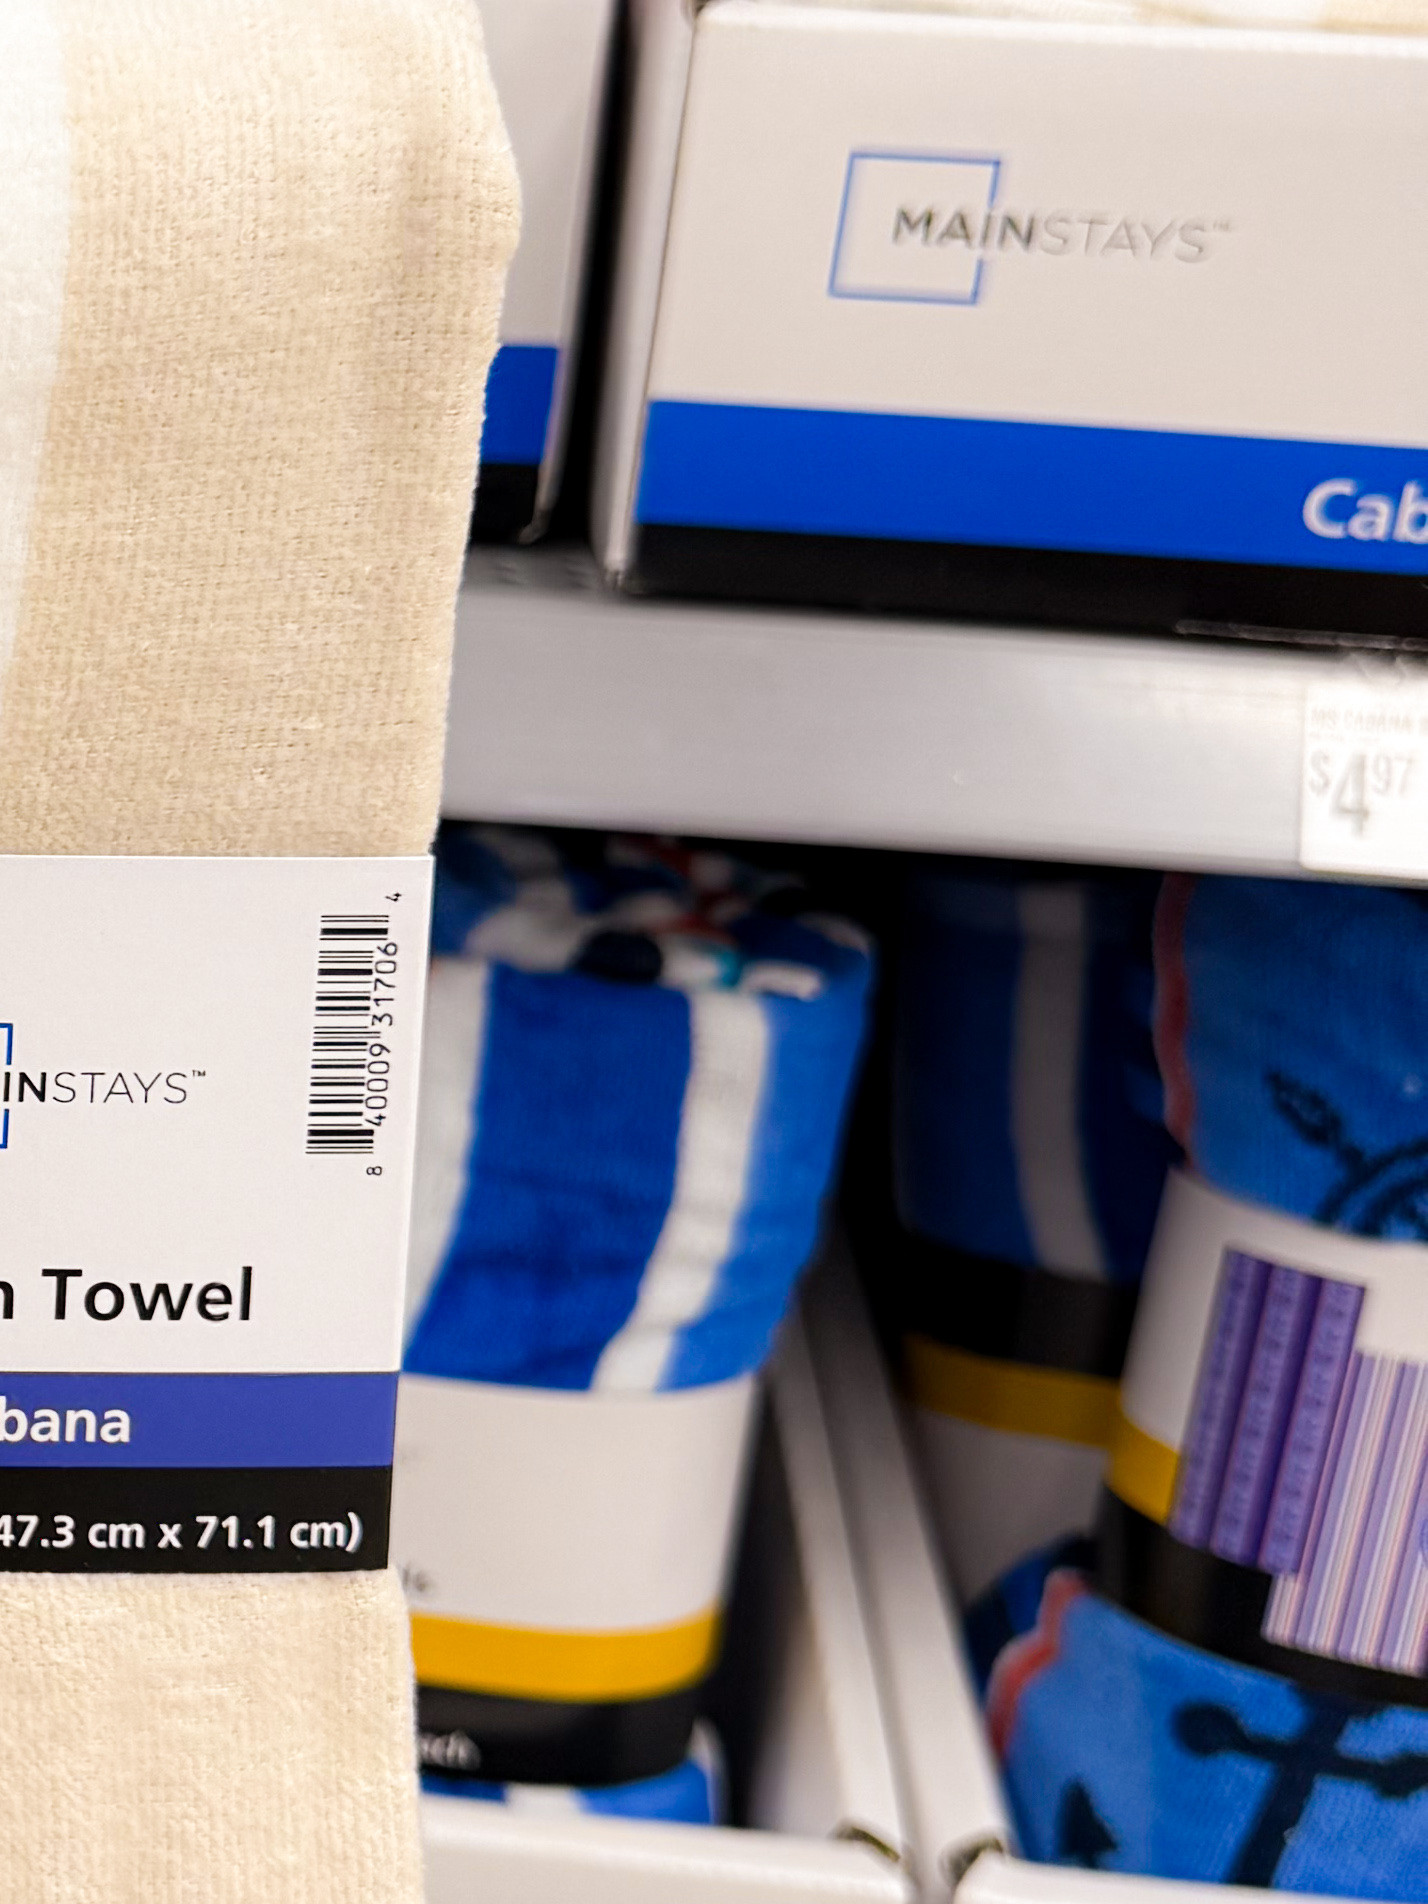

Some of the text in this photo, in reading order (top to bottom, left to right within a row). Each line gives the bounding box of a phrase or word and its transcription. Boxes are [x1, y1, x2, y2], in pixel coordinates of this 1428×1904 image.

[371, 941, 399, 1027] 31706
[364, 1042, 391, 1127] 40009
[41, 1266, 252, 1321] Towel
[87, 1522, 145, 1549] cm
[157, 1523, 183, 1549] x
[196, 1514, 277, 1549] 71.1
[290, 1511, 364, 1552] cm)
